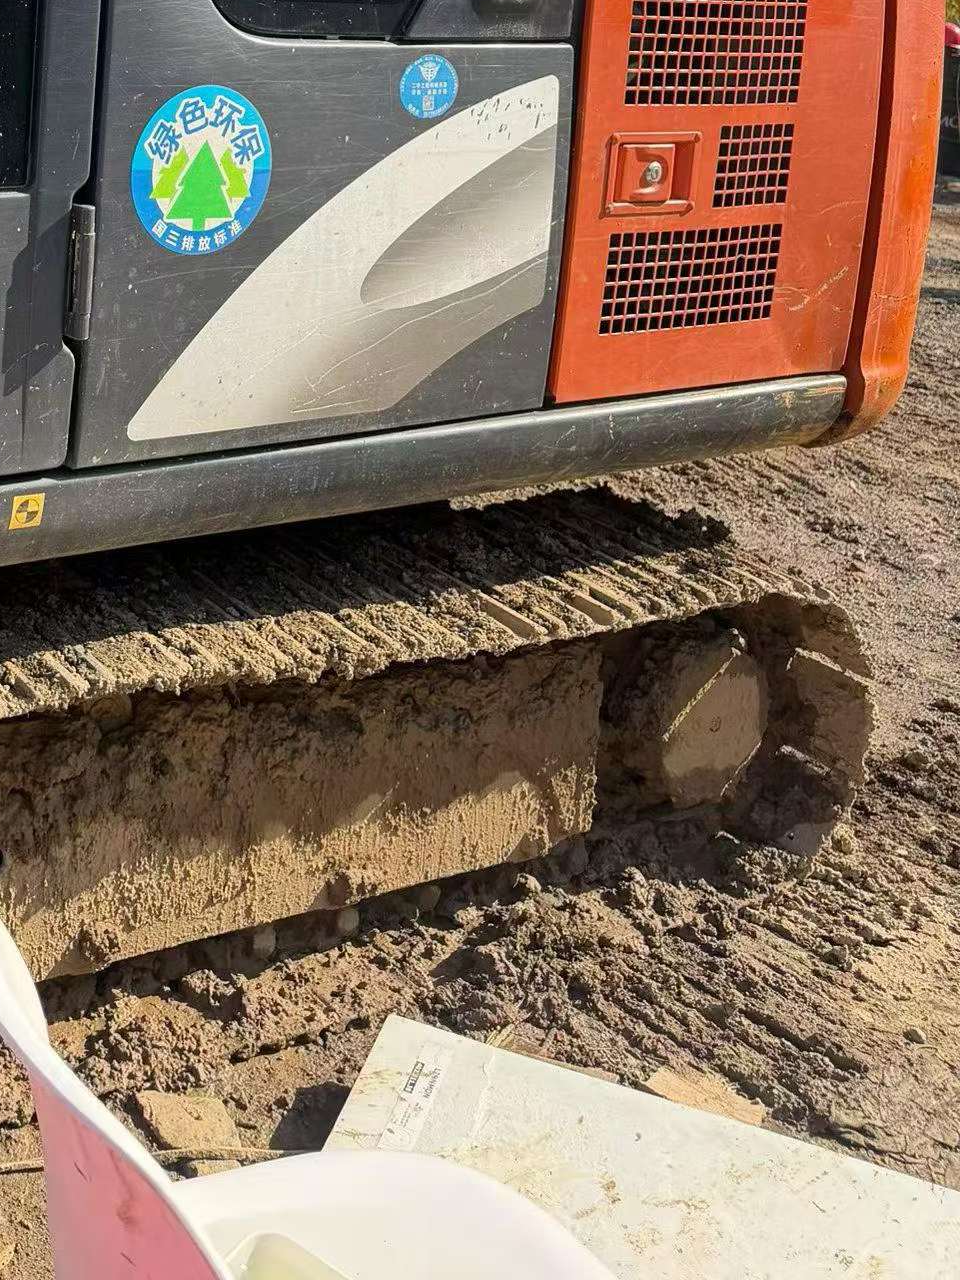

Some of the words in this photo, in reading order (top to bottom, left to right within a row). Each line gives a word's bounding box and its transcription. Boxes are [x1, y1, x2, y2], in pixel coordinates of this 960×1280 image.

[145, 95, 264, 166] 绿色环保
[151, 219, 243, 252] 国三排放标准
